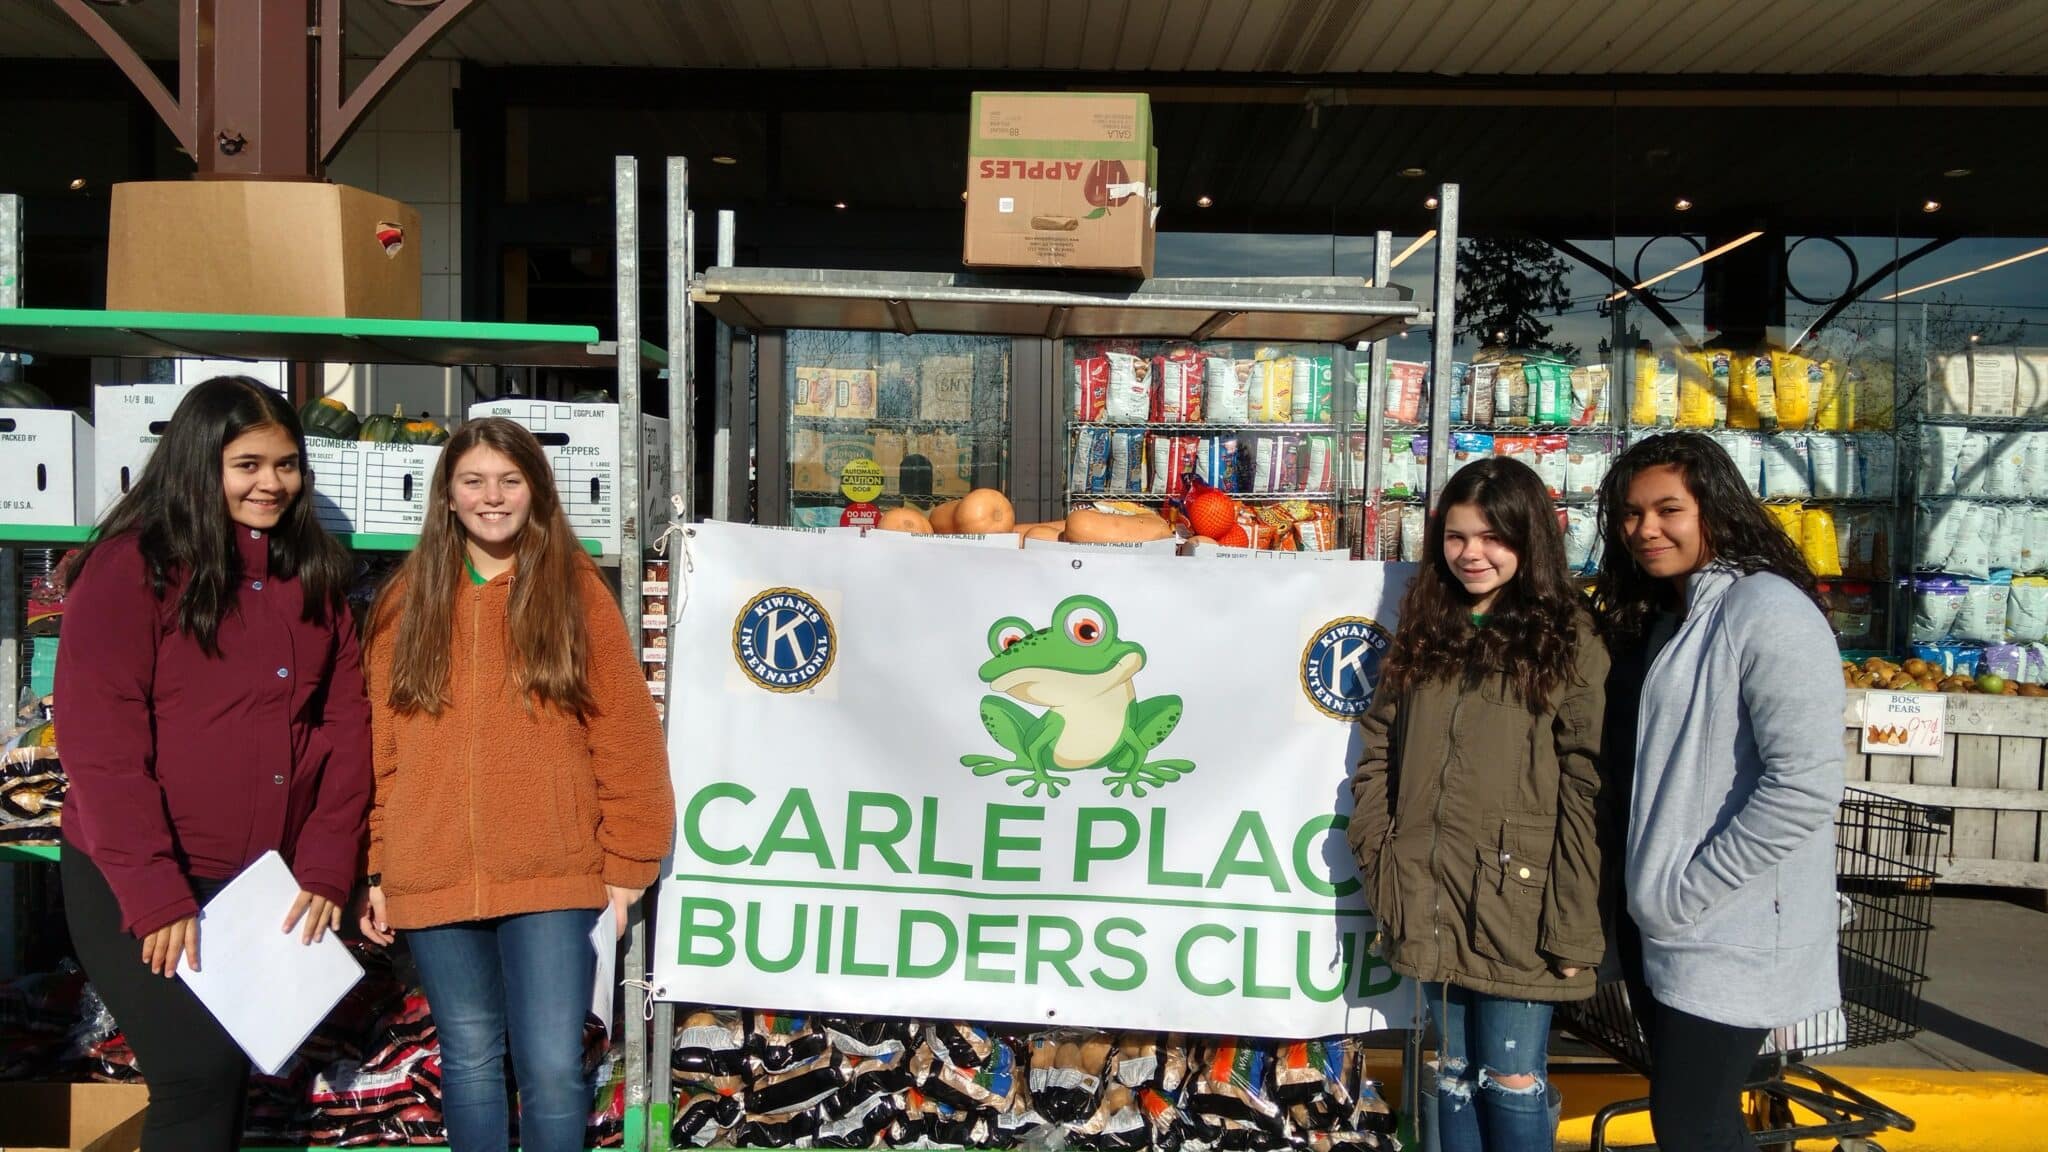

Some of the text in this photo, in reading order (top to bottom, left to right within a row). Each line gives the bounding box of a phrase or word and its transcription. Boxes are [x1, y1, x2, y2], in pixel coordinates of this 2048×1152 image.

[1107, 129, 1132, 139] GALA
[980, 159, 1083, 181] APPLES
[491, 407, 512, 416] ACORN
[573, 409, 605, 418] EGGPLANT
[1, 434, 27, 442] PACKED
[374, 440, 414, 453] PEPPERS
[560, 446, 600, 456] PEPPERS
[843, 476, 881, 485] CAUTION
[3, 501, 33, 510] OF U.S.A.
[847, 510, 857, 518] DO
[754, 596, 821, 623] KIWANIS
[764, 609, 808, 670] K
[1320, 625, 1387, 649] KIWANIS
[741, 627, 828, 683] INTERNATIONAL
[1329, 638, 1375, 700] K
[1891, 695, 1920, 704] BOSC
[1888, 704, 1921, 713] PEARS
[683, 781, 1362, 898] CARLE PLAC
[677, 896, 1402, 1003] BUILDERS CLUB
